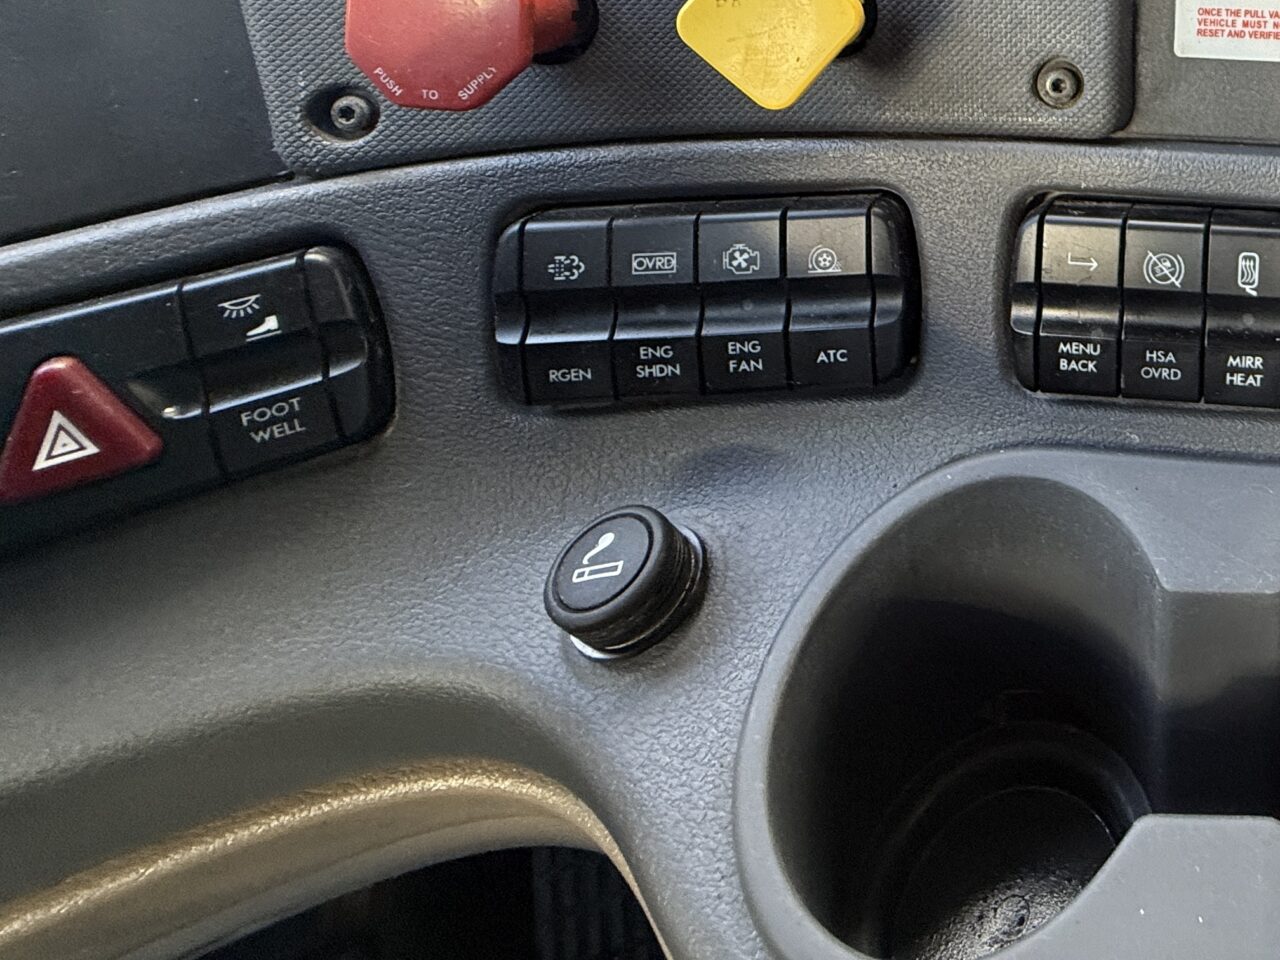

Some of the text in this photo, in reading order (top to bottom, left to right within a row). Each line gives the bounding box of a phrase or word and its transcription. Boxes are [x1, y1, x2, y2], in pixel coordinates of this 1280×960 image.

[1196, 29, 1225, 38] RESET
[1227, 29, 1246, 39] AND
[373, 66, 403, 97] PUSH
[421, 89, 439, 100] TO
[633, 256, 676, 270] OVRD
[639, 345, 674, 359] ENG
[728, 341, 762, 355] ENG
[1058, 342, 1100, 356] MENU
[816, 349, 849, 363] ATC
[1145, 350, 1176, 364] HSA
[1227, 355, 1264, 370] MIRR
[636, 363, 681, 378] SHDN
[729, 358, 763, 373] FAN
[1059, 358, 1098, 374] BACK
[549, 367, 592, 382] RGEN
[1141, 366, 1182, 381] OVRD
[1225, 372, 1264, 387] HEAT
[240, 397, 301, 427] FOOT
[250, 418, 306, 443] WELL
